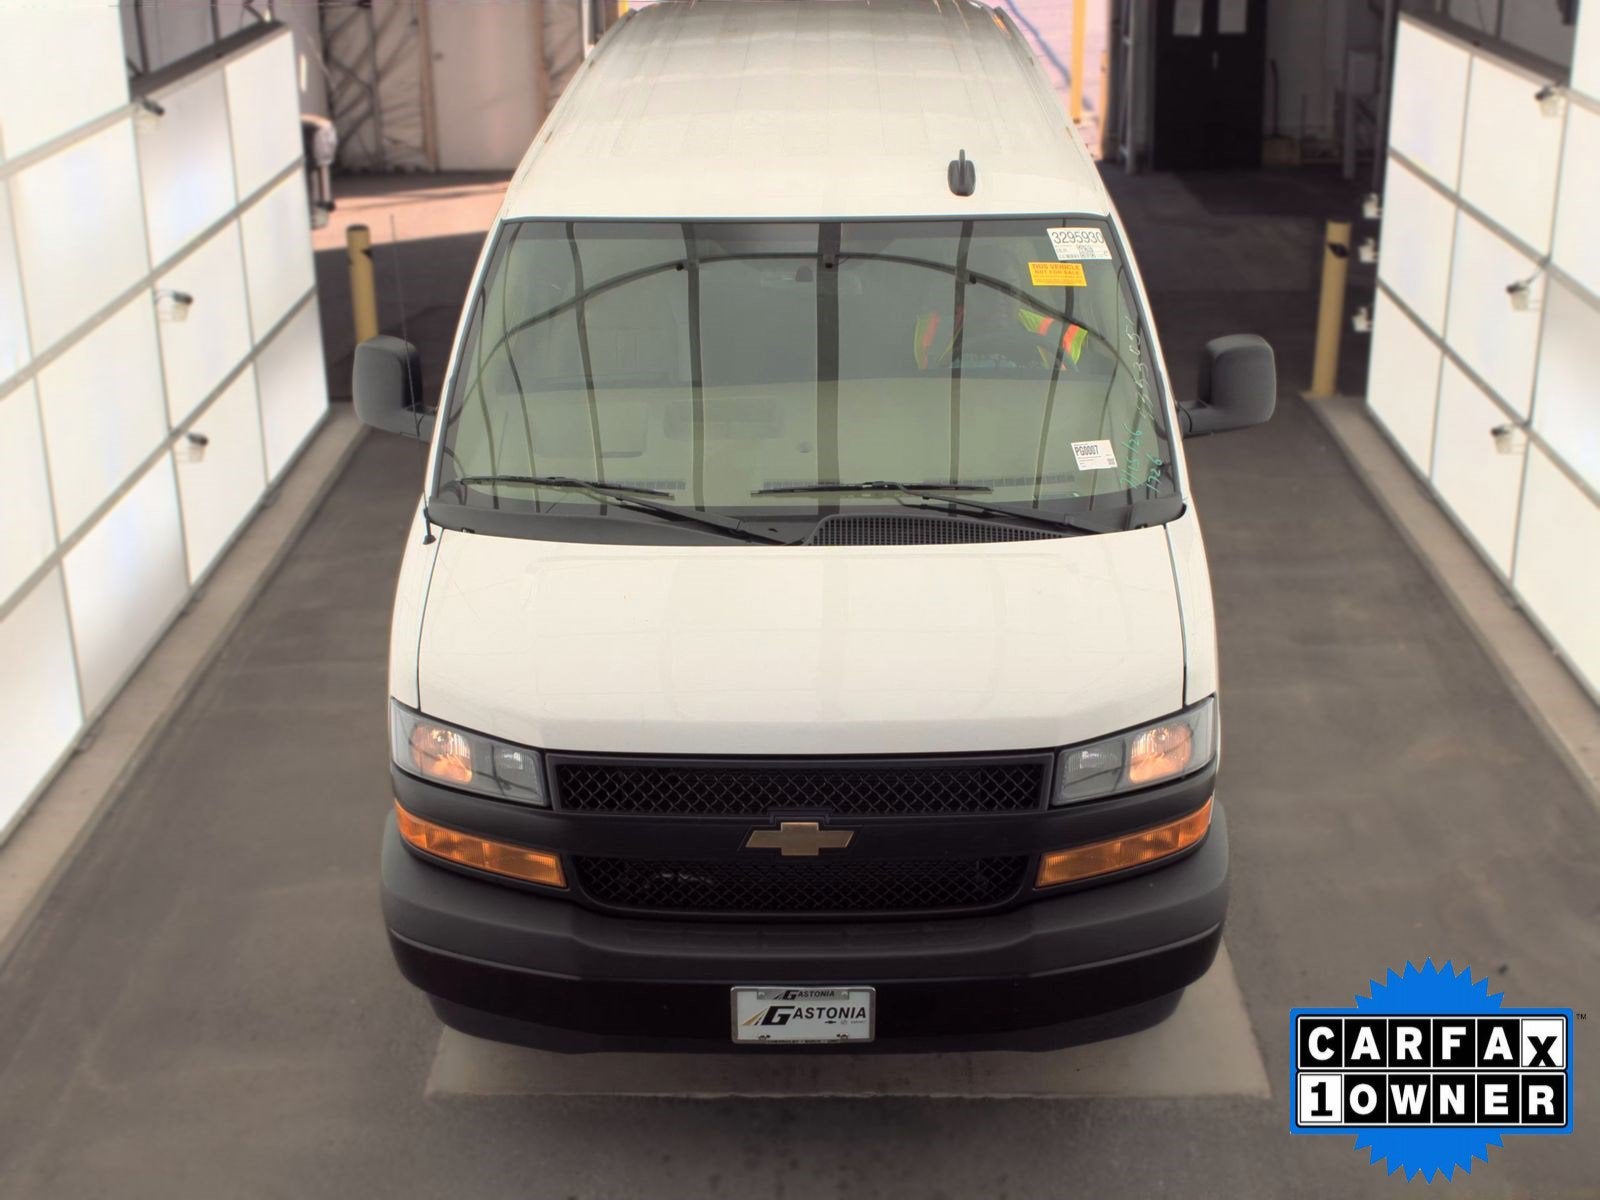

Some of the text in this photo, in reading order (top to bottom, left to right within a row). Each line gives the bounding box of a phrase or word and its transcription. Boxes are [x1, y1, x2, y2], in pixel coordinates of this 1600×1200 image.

[1051, 231, 1105, 244] 3295930
[782, 990, 835, 1001] GASTONIA
[761, 1005, 867, 1026] GASTONIA
